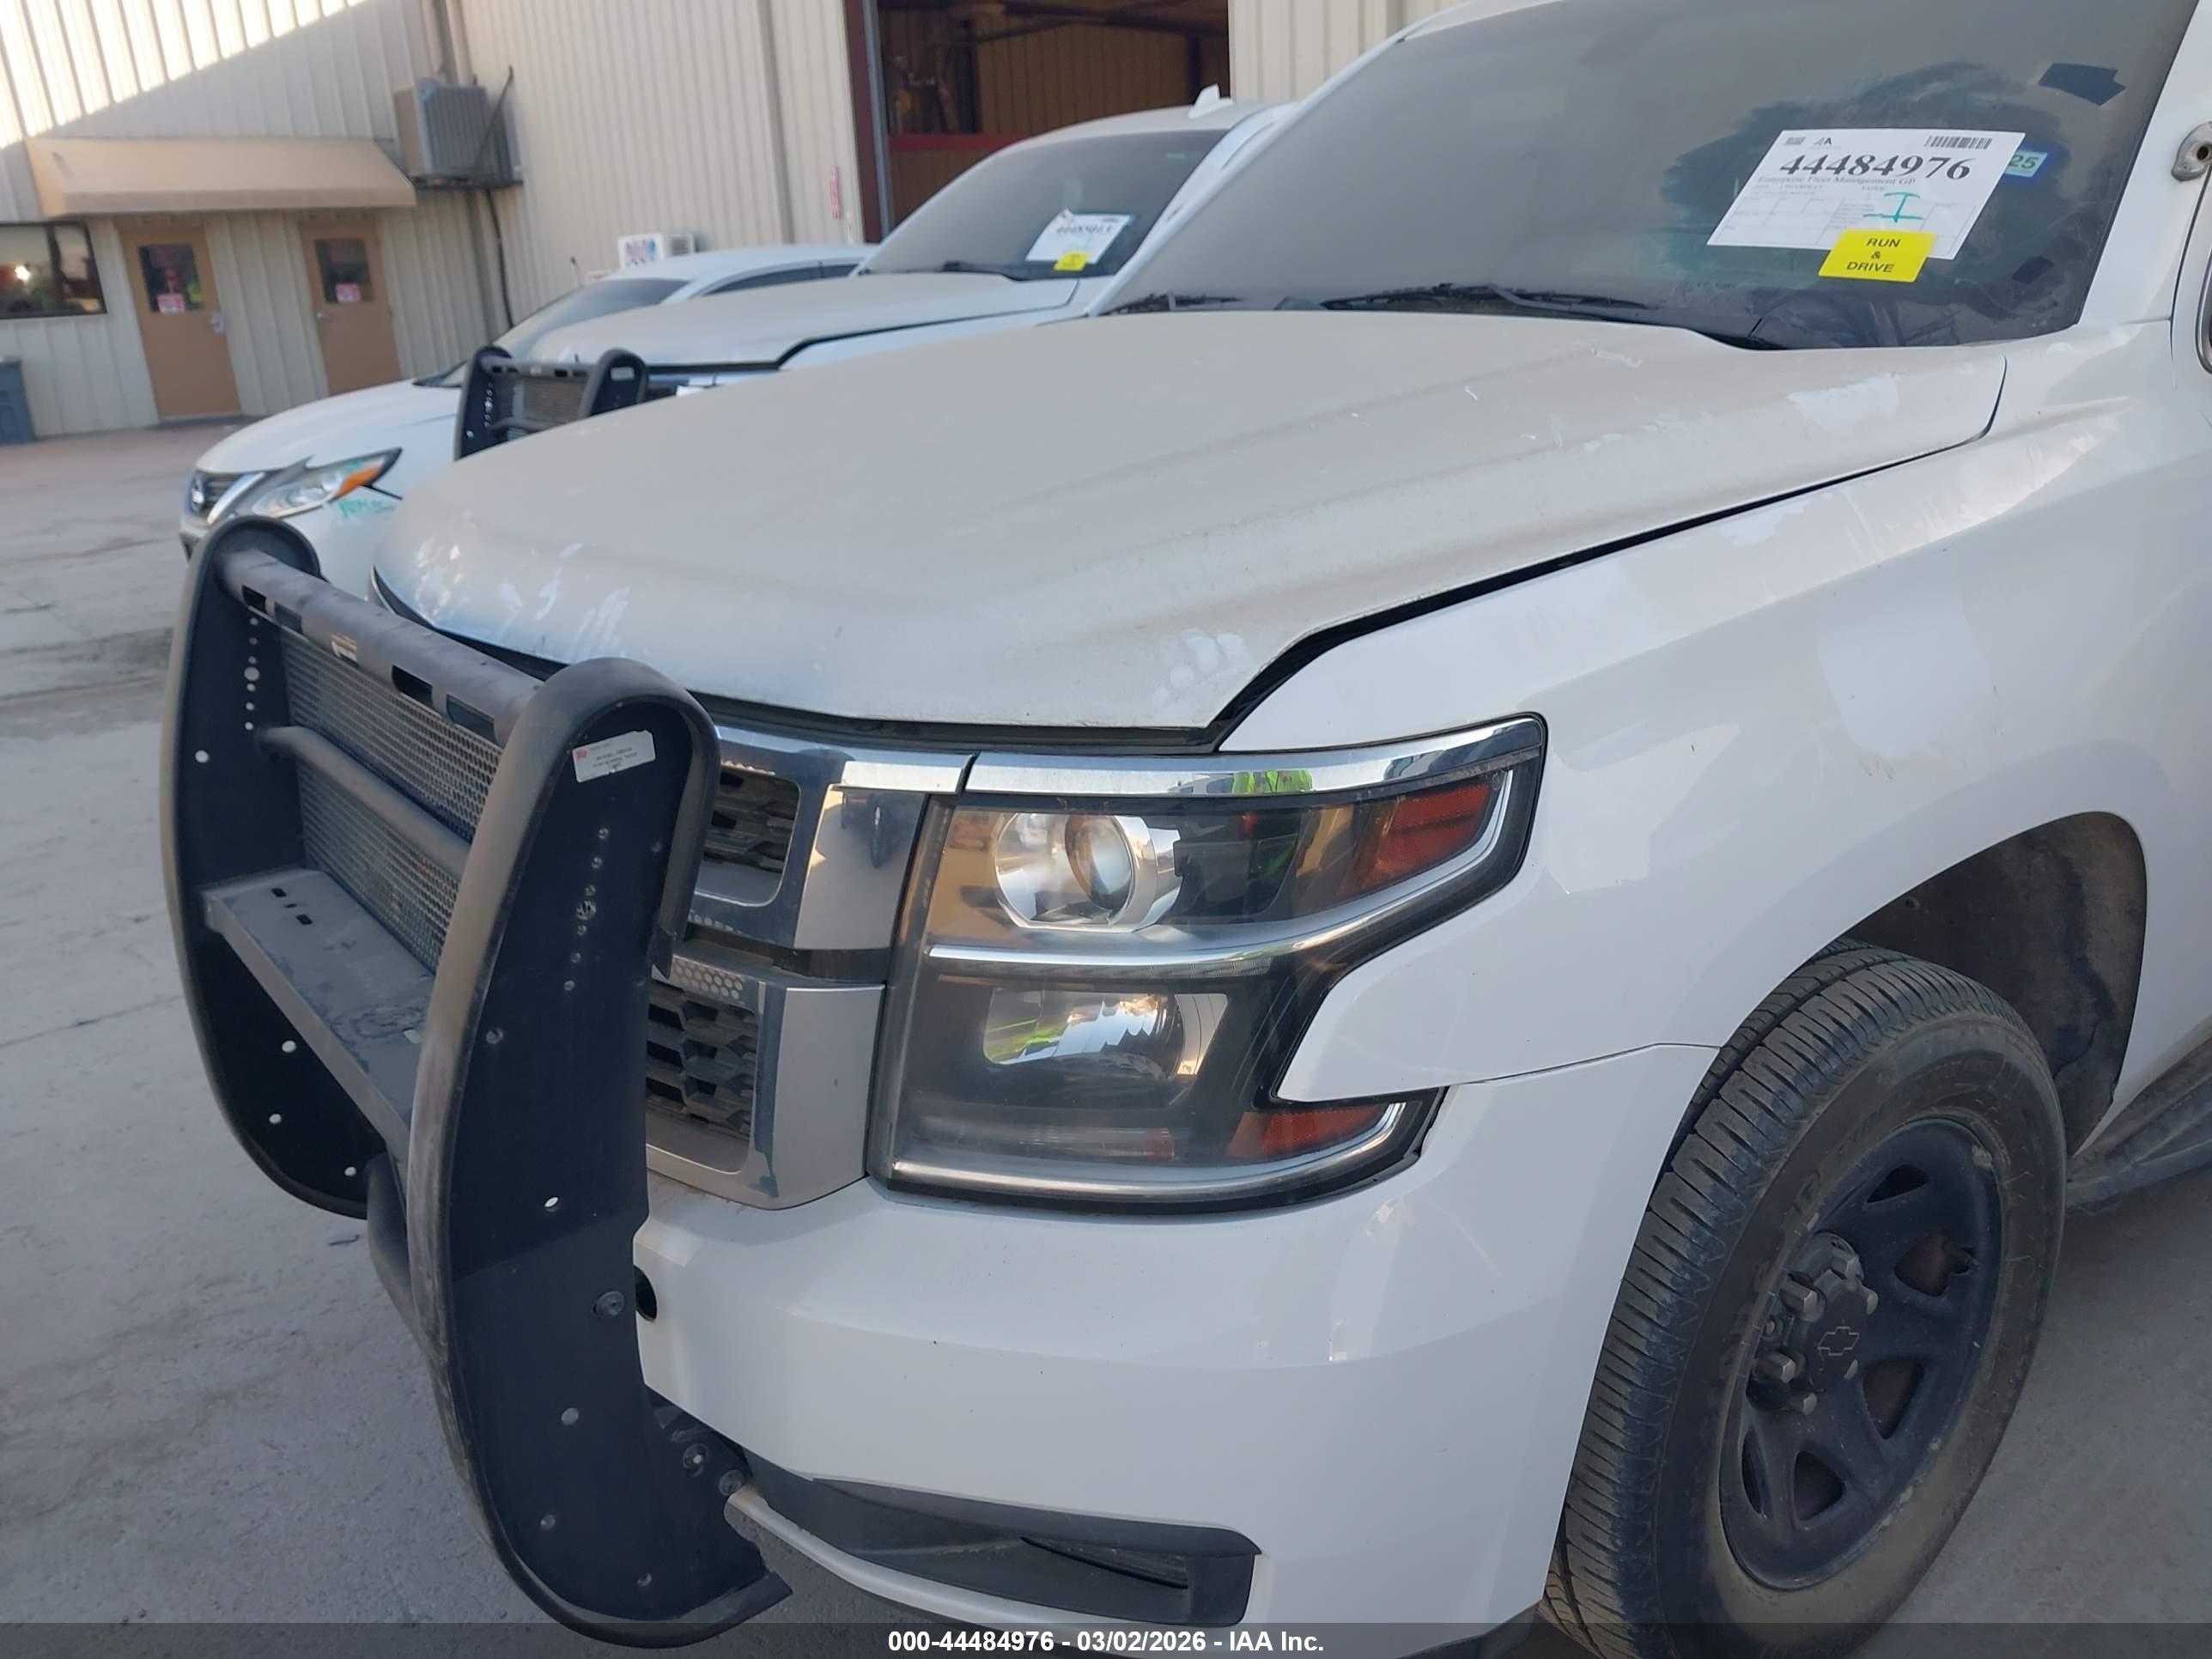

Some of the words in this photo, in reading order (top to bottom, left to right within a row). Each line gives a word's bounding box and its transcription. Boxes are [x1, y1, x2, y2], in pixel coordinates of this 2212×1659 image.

[1779, 154, 1977, 179] 44484976
[2008, 154, 2040, 170] 25
[1866, 237, 1901, 248] RUN
[1870, 251, 1881, 260] &
[1846, 260, 1895, 273] DRIVE
